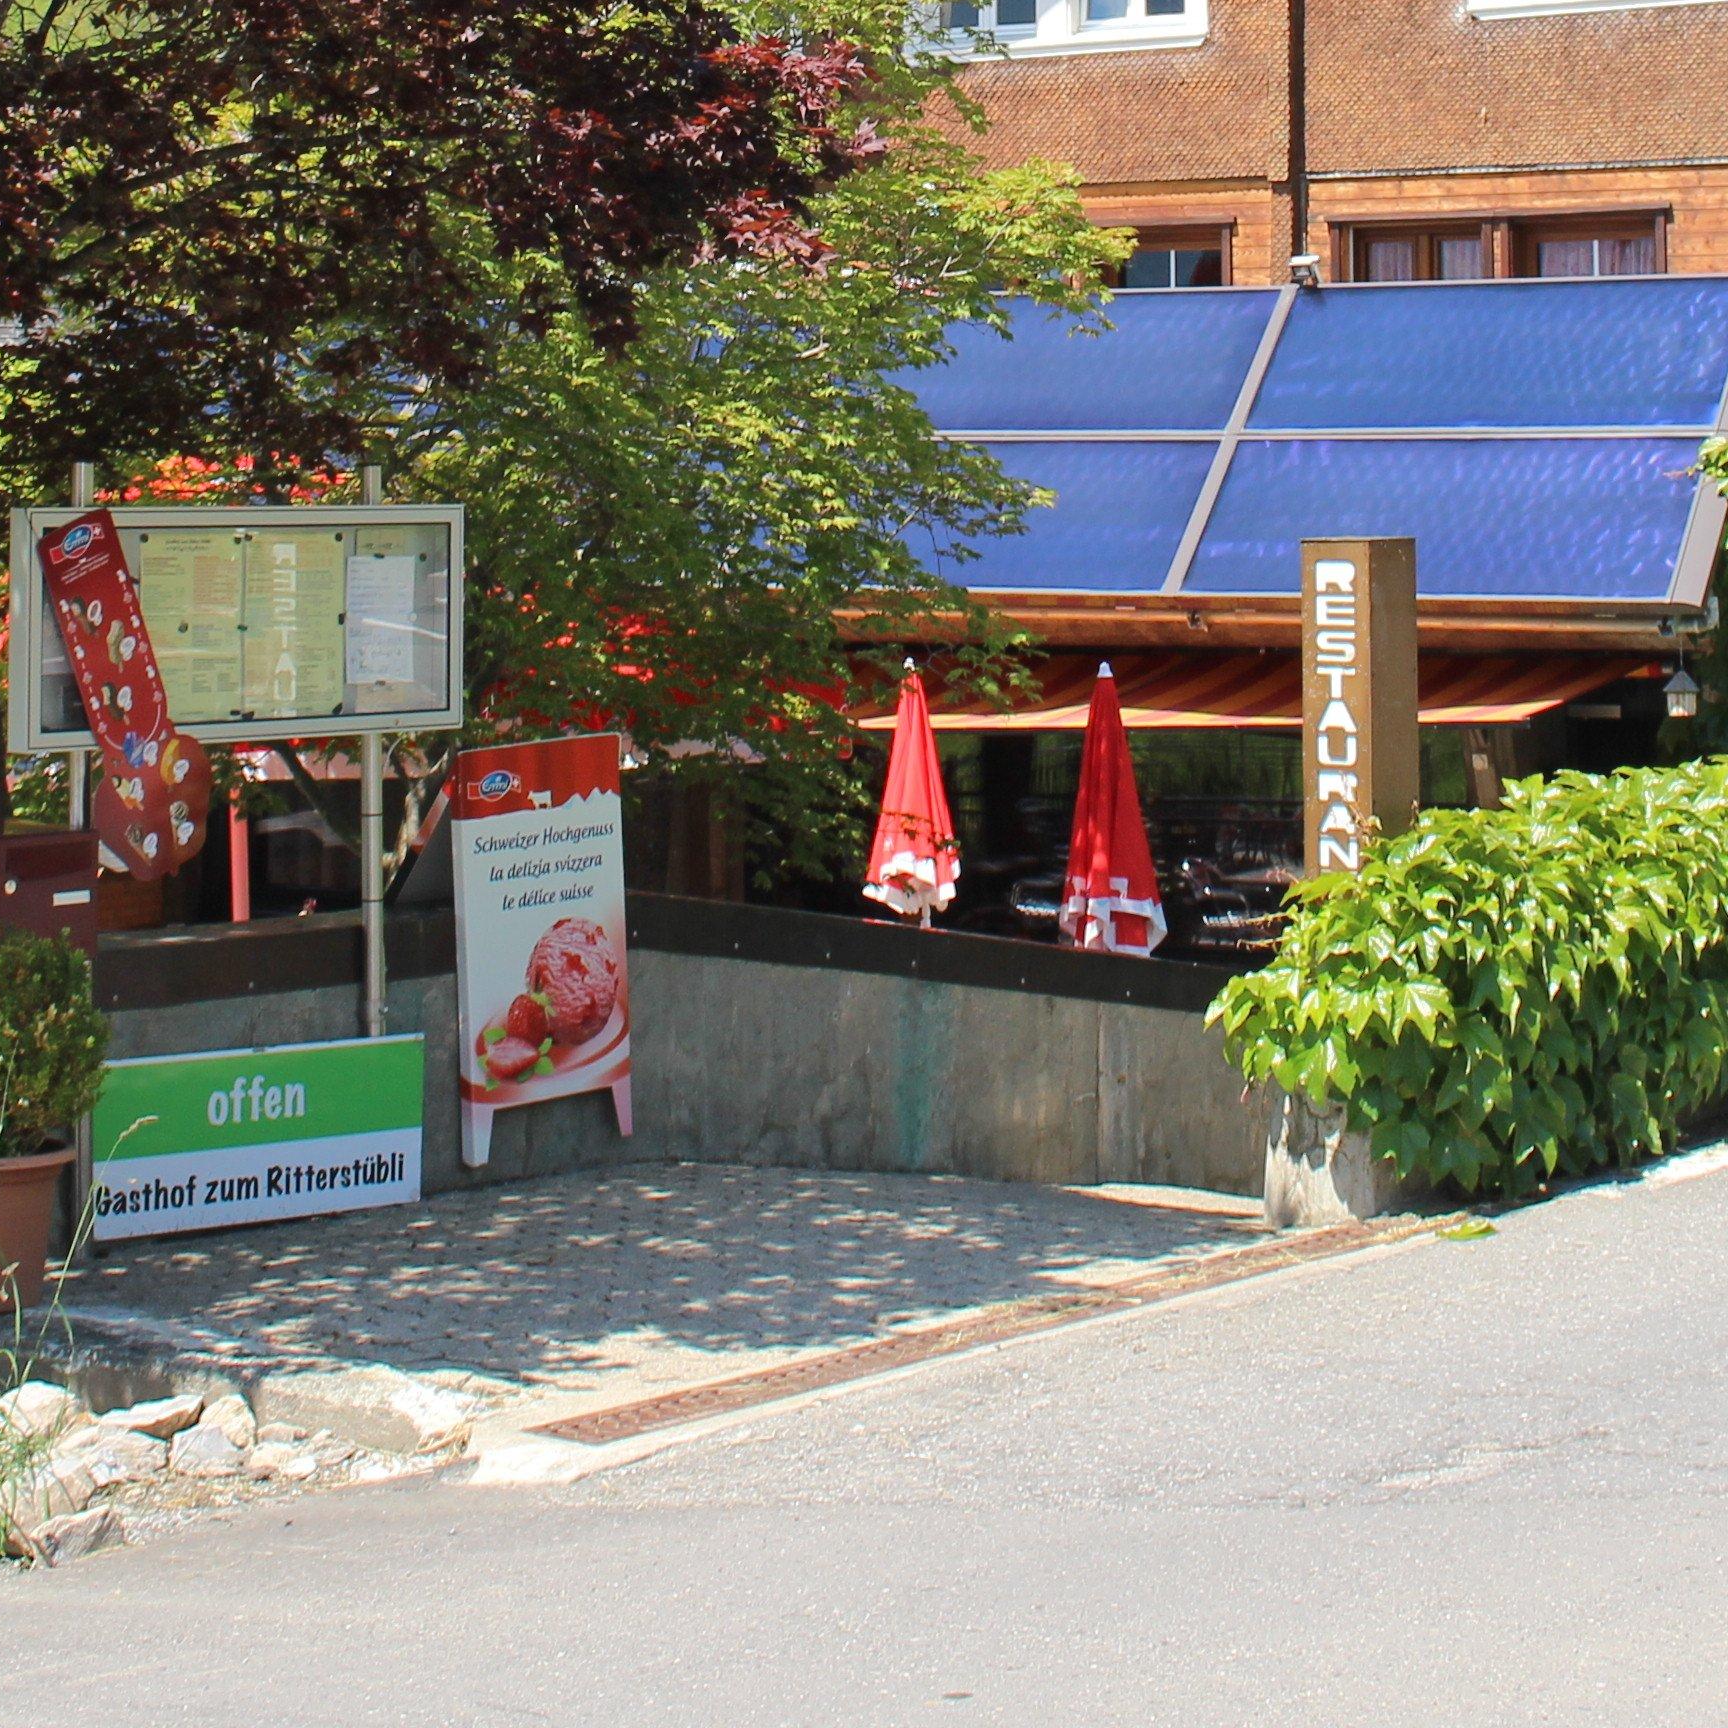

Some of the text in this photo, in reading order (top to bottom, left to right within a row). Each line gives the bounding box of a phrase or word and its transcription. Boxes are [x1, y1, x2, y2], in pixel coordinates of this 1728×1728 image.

[1315, 558, 1358, 874] RESTAURAN
[474, 822, 615, 855] Schweizer Hochgenuss
[489, 854, 603, 882] la delizia svizzera
[502, 883, 594, 911] le délice suisse
[207, 1074, 306, 1127] offen
[95, 1151, 405, 1217] Gasthof zum Ritterstübli
